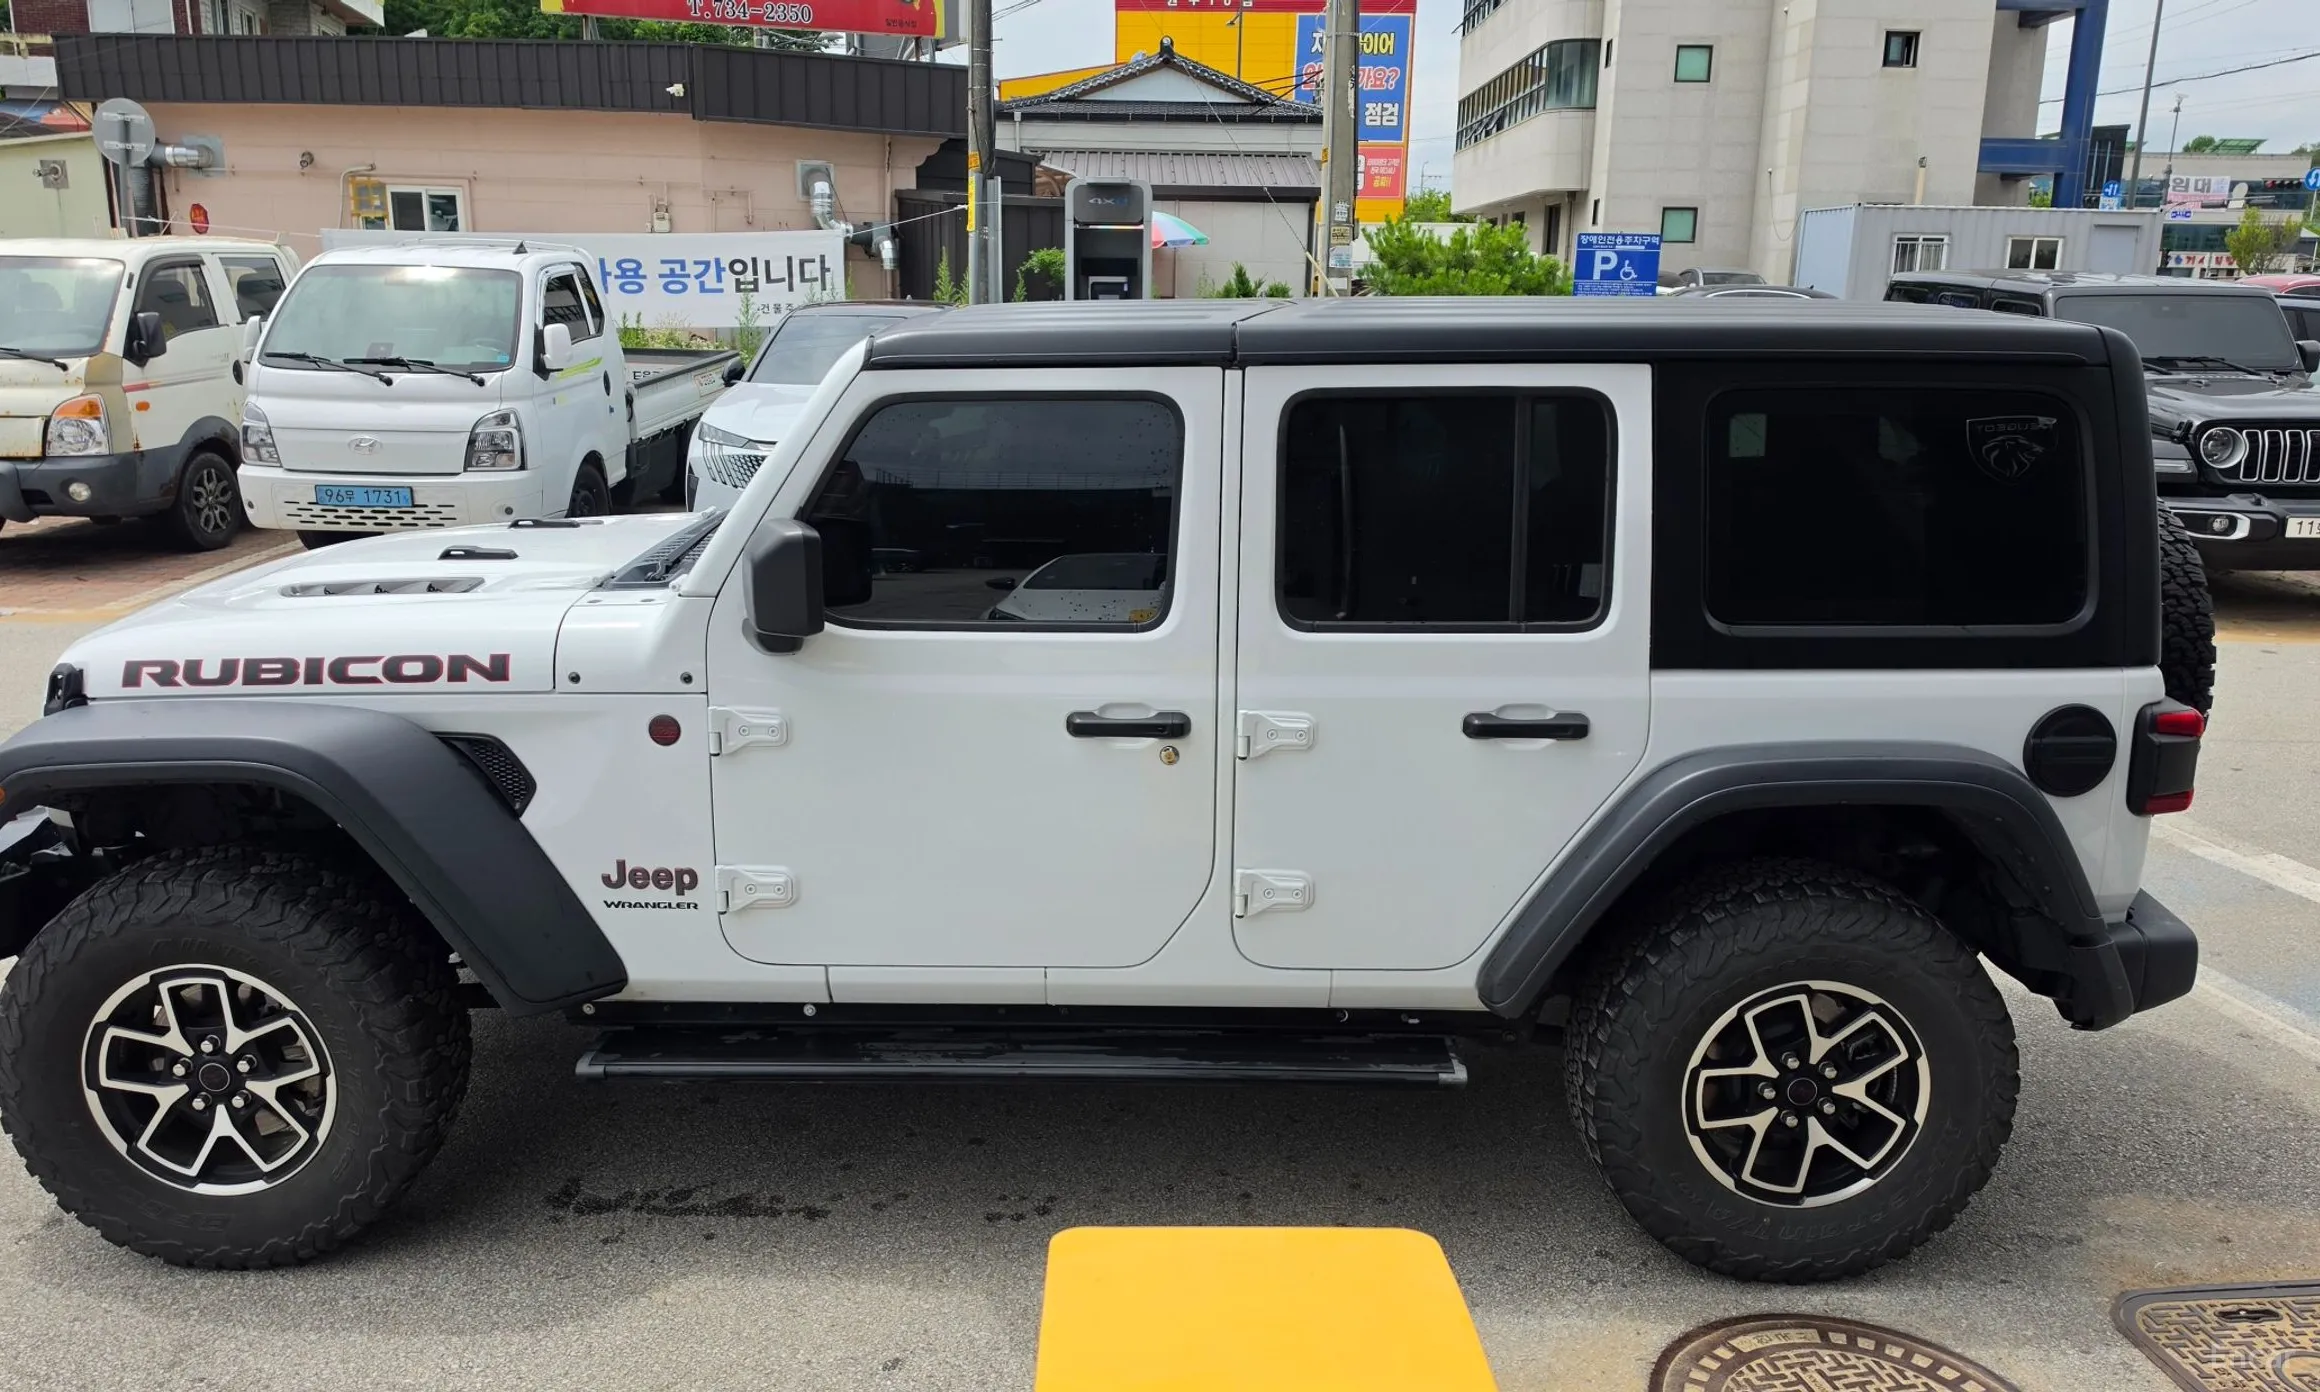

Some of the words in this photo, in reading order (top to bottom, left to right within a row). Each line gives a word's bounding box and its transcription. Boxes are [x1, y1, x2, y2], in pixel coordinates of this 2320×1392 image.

[688, 0, 813, 24] T.734-2350
[1365, 102, 1400, 126] 점검
[2172, 176, 2212, 193] 임대
[1580, 235, 1660, 245] 장애인전용주차구역
[657, 253, 831, 295] 공간입니다
[1592, 250, 1618, 280] P
[324, 488, 355, 504] 96무
[364, 489, 401, 504] 1731
[121, 653, 511, 689] RUBICON
[601, 859, 699, 896] Jeep
[603, 900, 699, 910] WRANGLER
